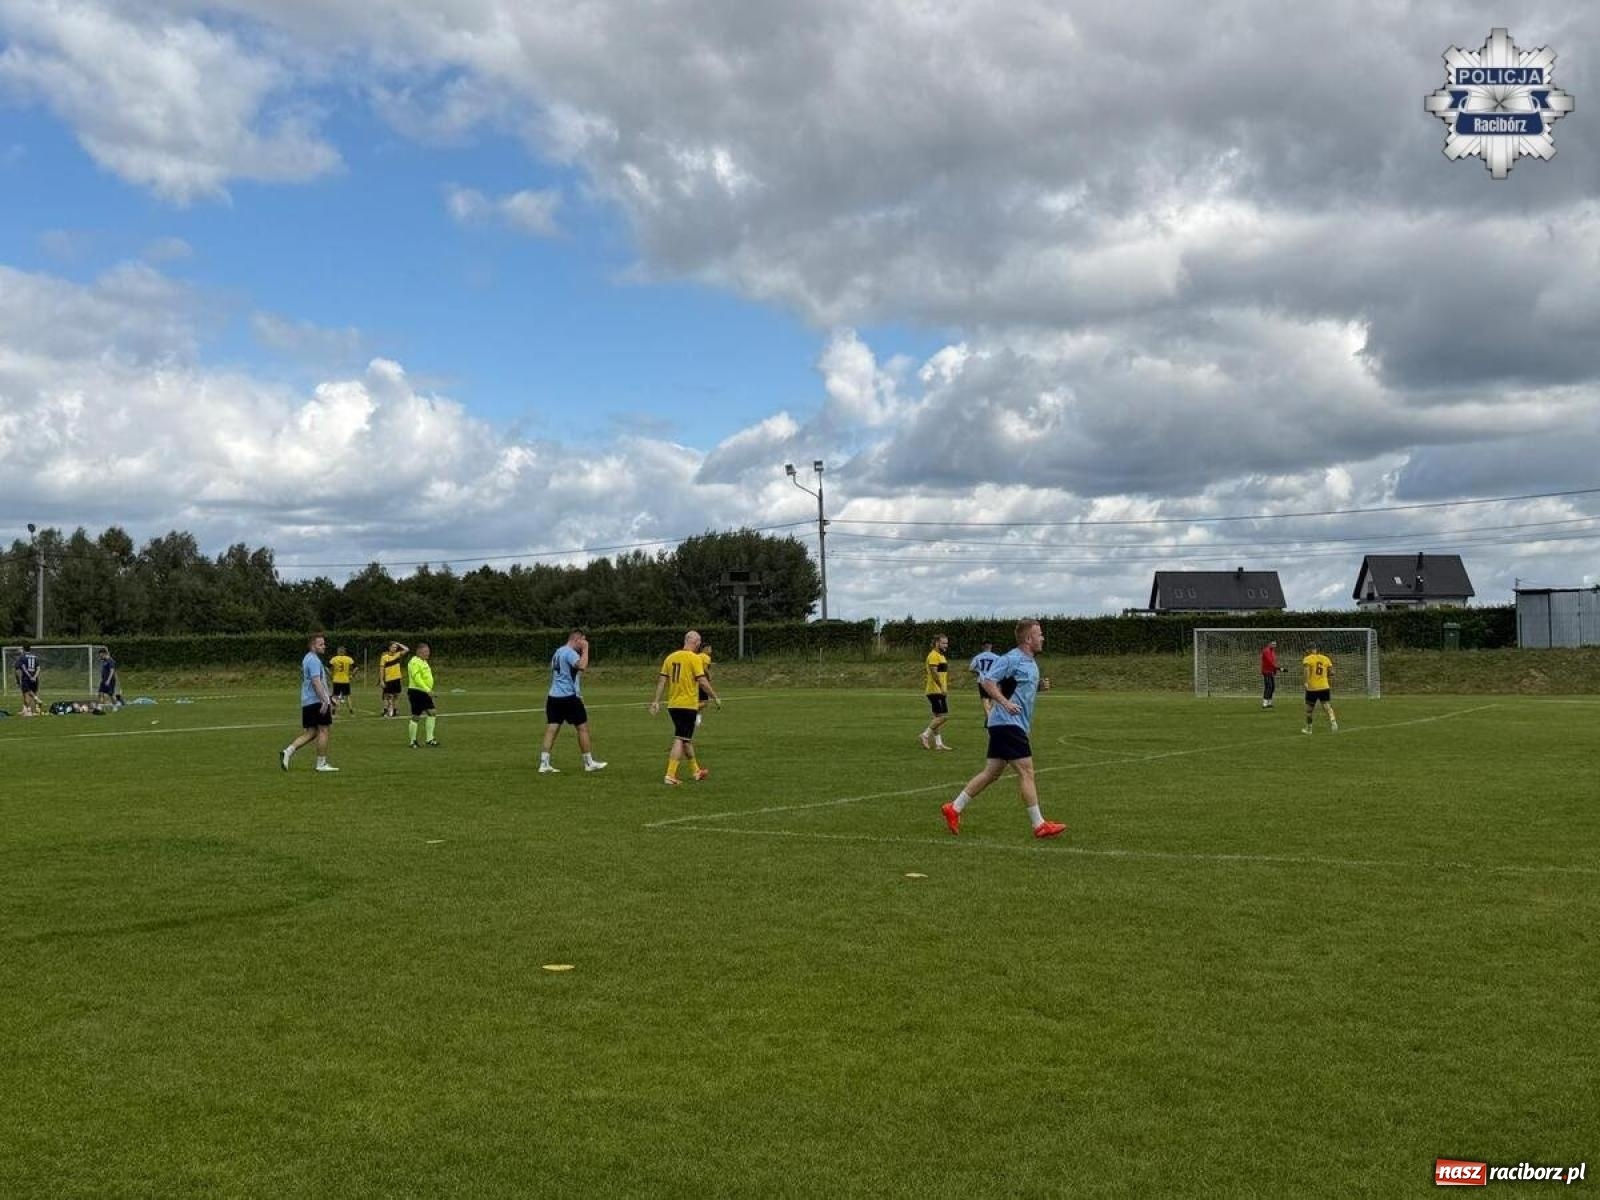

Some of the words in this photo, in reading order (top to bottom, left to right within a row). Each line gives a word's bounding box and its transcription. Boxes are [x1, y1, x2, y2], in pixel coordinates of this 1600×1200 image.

[979, 659, 994, 671] 17
[1315, 661, 1324, 675] 6
[672, 662, 681, 684] 11
